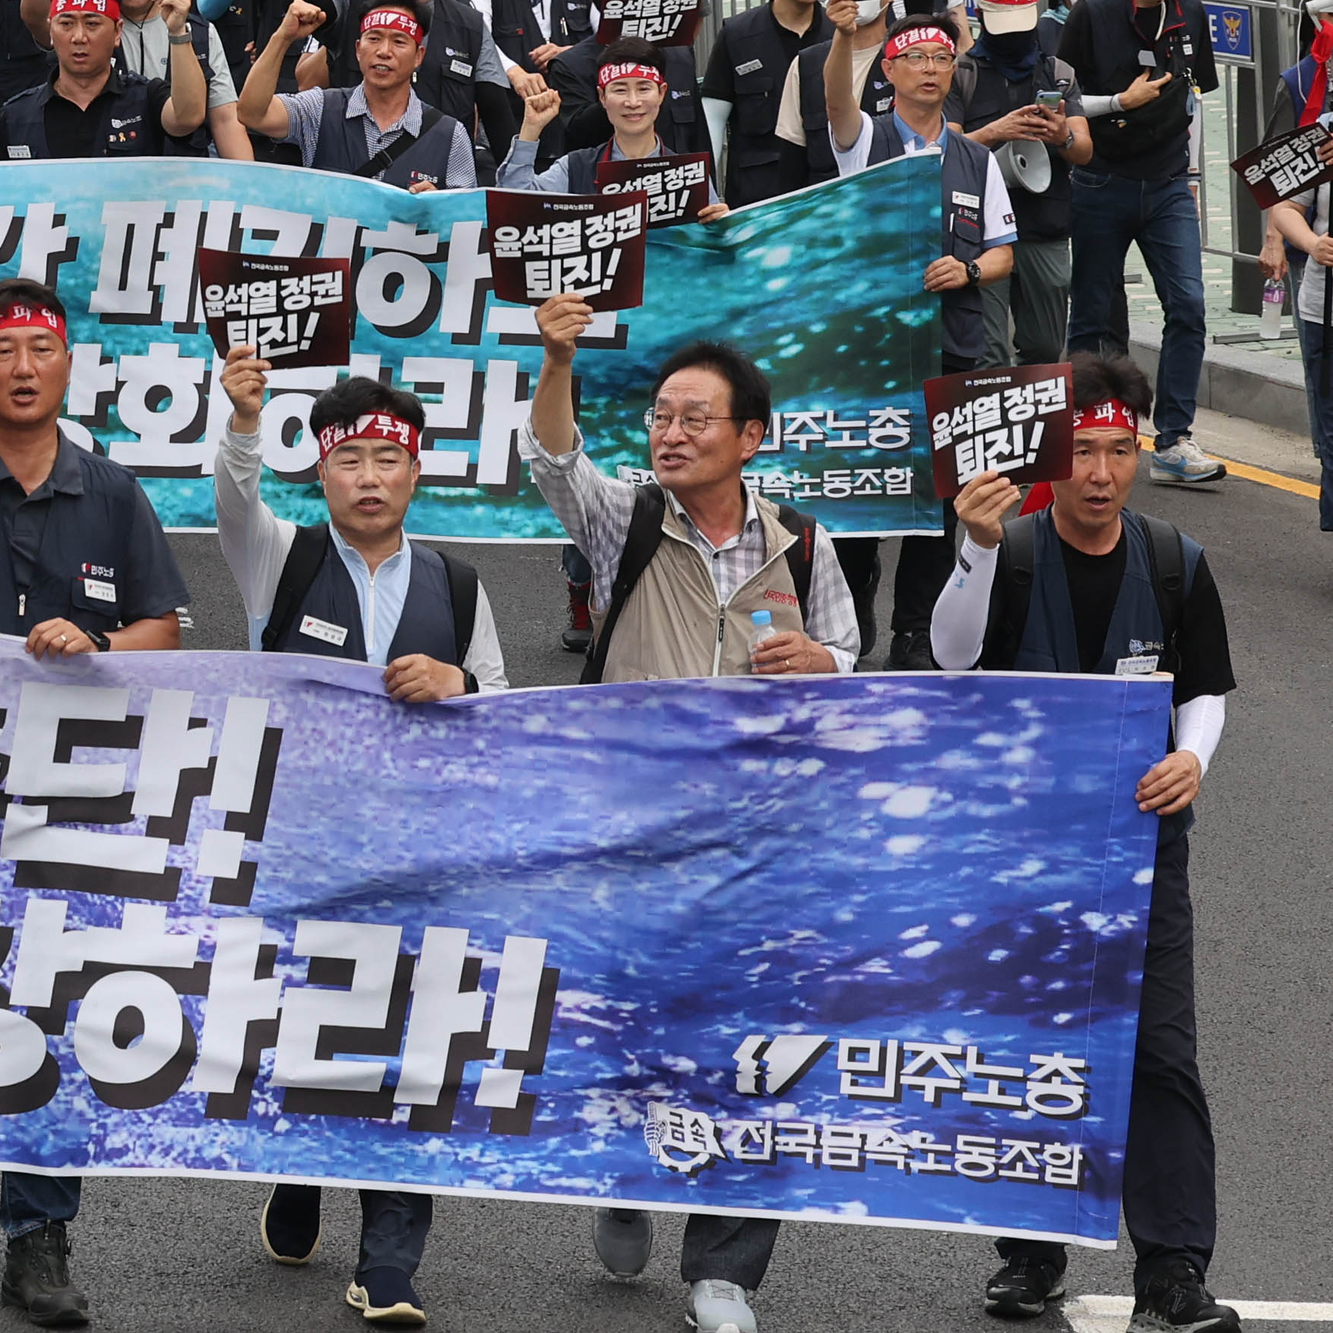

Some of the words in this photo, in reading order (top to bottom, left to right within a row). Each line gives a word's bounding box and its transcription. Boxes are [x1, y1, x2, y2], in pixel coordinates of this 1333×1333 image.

[620, 13, 683, 42] 퇴진!
[1242, 140, 1294, 187] 윤석열
[1290, 126, 1326, 163] 정권
[1274, 155, 1328, 198] 퇴진!
[492, 219, 583, 258] 윤석열
[583, 201, 643, 246] 정권
[205, 281, 277, 318] 윤석열
[279, 269, 344, 311] 정권
[524, 247, 622, 299] 퇴진!
[227, 311, 320, 360] 퇴진!
[374, 415, 410, 445] 투쟁
[930, 397, 1003, 451] 윤석열
[1002, 375, 1068, 425] 정권
[954, 421, 1046, 486] 퇴진!
[836, 1037, 1086, 1116] 민주노총
[733, 1119, 1083, 1186] 전국금속노동조합
